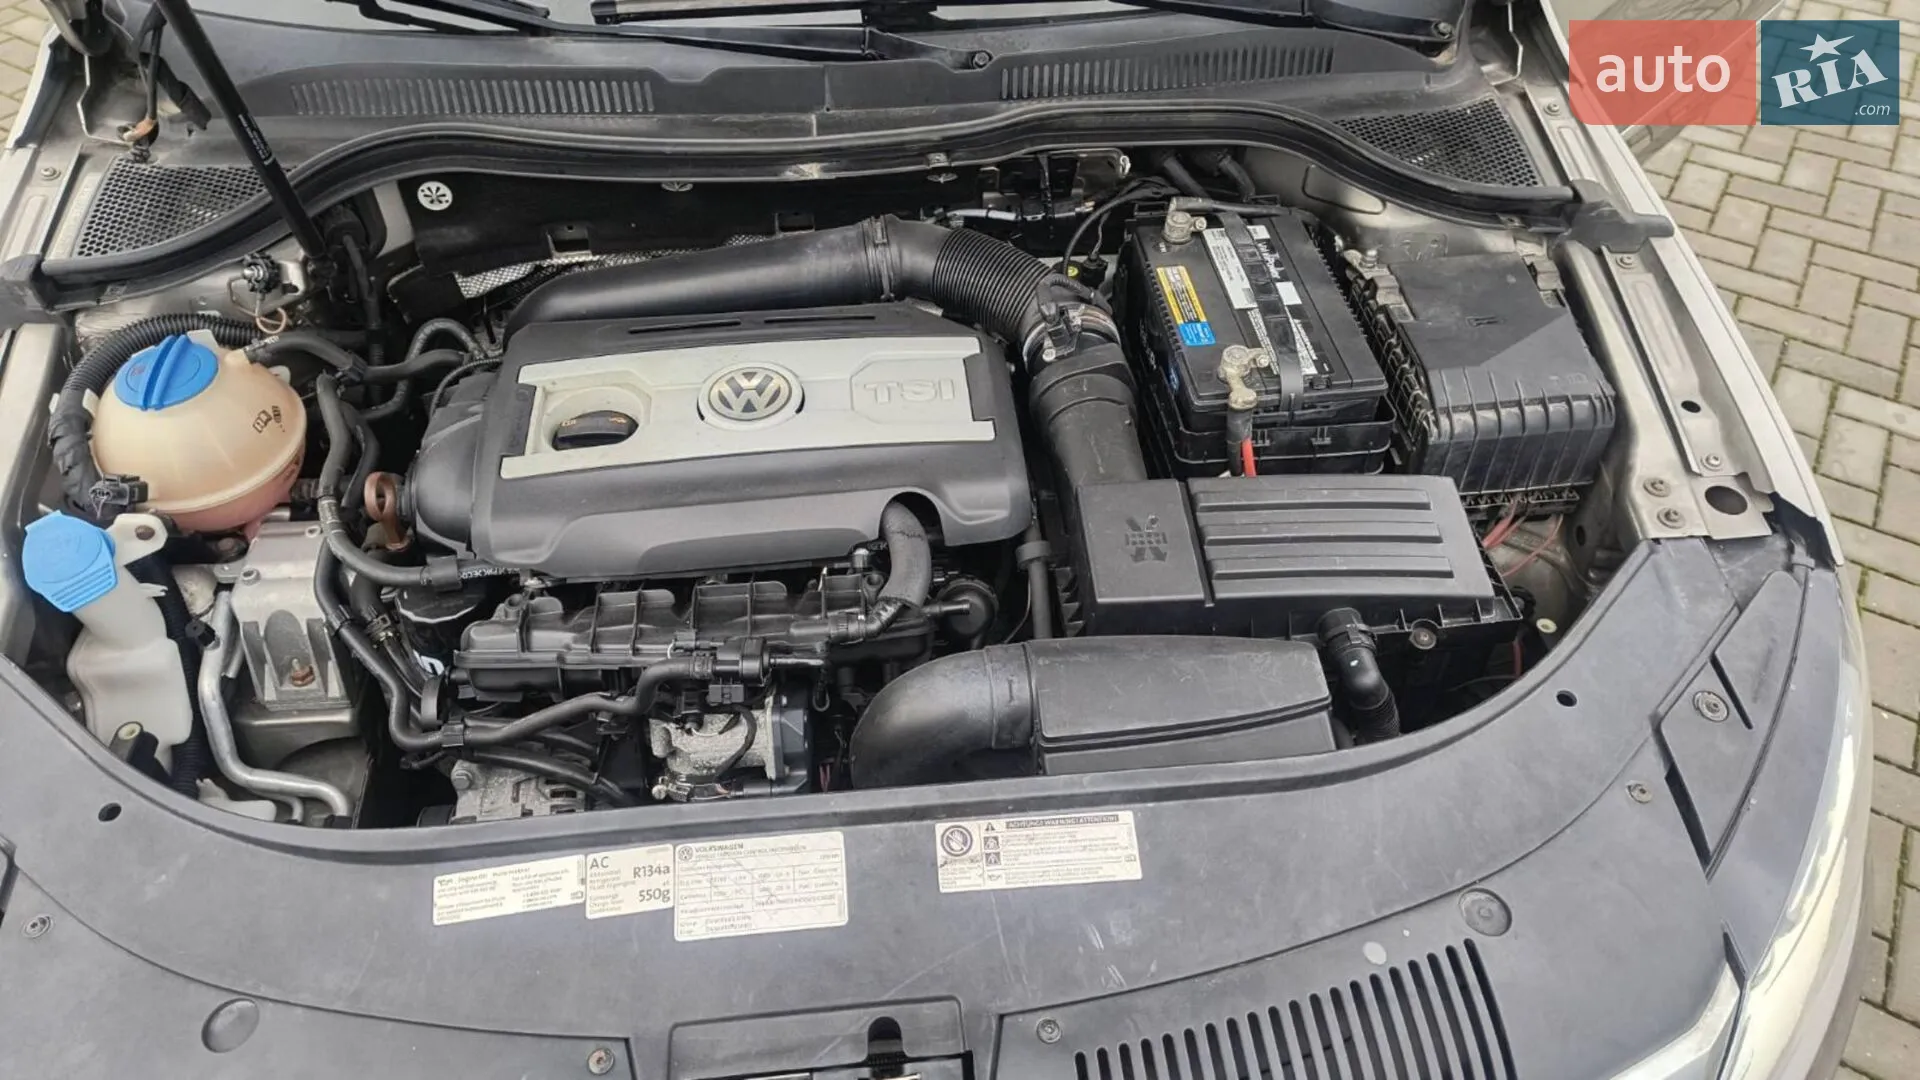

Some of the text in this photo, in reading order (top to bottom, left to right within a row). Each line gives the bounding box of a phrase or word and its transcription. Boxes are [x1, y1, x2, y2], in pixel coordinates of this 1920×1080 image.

[864, 378, 955, 404] TSI
[695, 842, 744, 853] VOLKSWAGEN
[590, 856, 610, 870] AC
[632, 864, 671, 879] R134a
[638, 887, 671, 904] 550g
